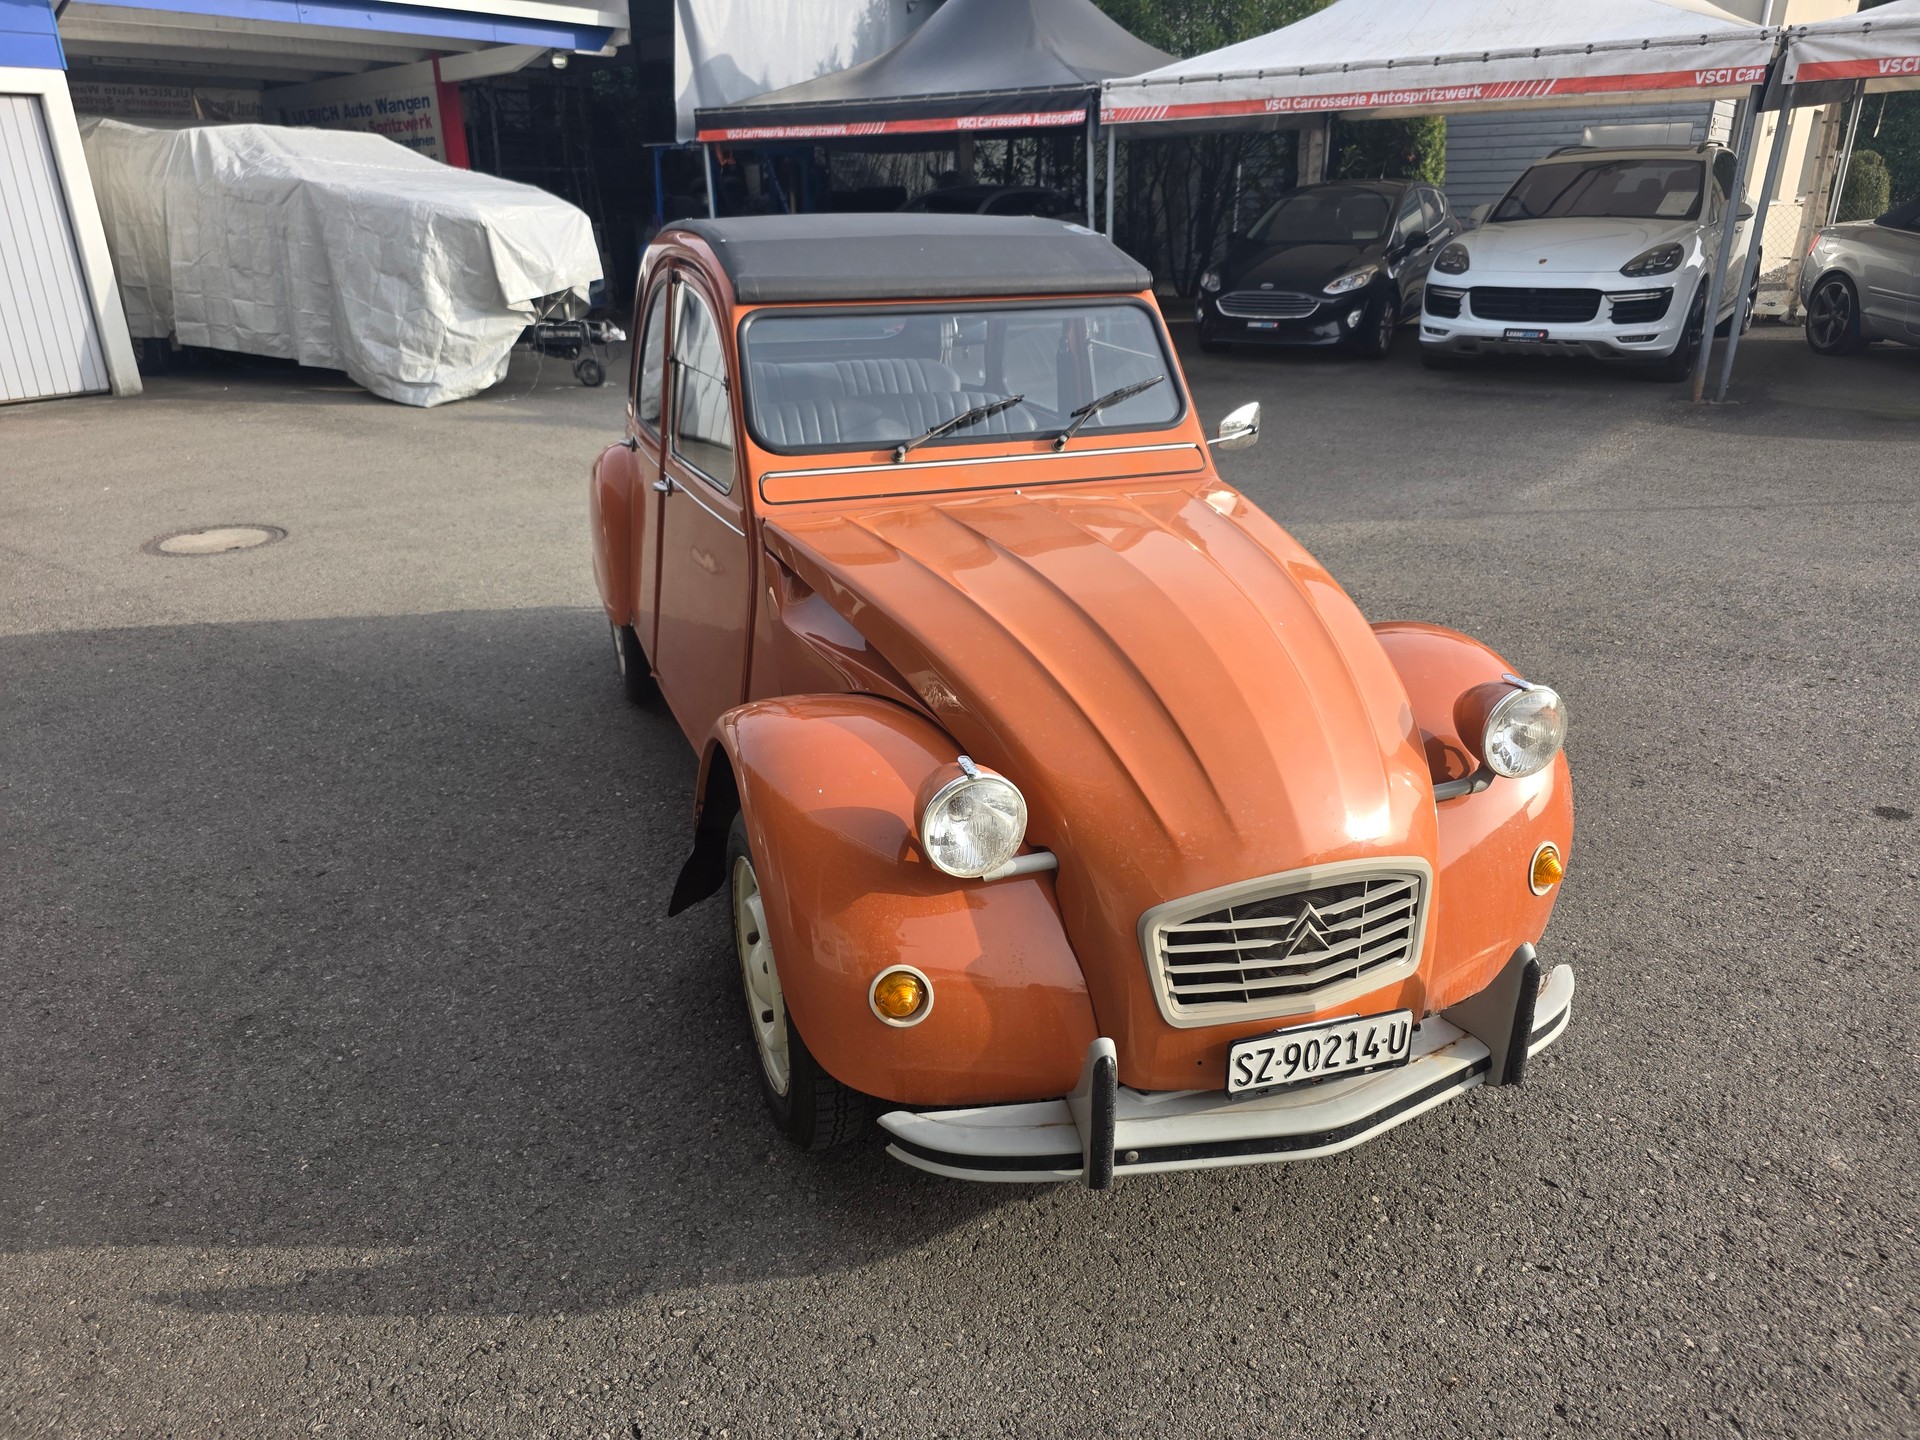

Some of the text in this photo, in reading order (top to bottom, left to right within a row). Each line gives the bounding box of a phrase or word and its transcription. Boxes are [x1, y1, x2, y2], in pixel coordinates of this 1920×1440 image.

[1878, 57, 1920, 74] VSCI
[1695, 67, 1767, 85] VSCI Car
[1264, 85, 1483, 112] VSCI Carrosserie Autospritzwerk
[292, 96, 431, 124] ULRICH Auto Wangen
[368, 113, 433, 135] Spritzwerk
[957, 118, 977, 129] VSCI
[978, 114, 1032, 128] Carrosserie
[726, 124, 847, 140] VSCI Carrosserie Autospritzwerk
